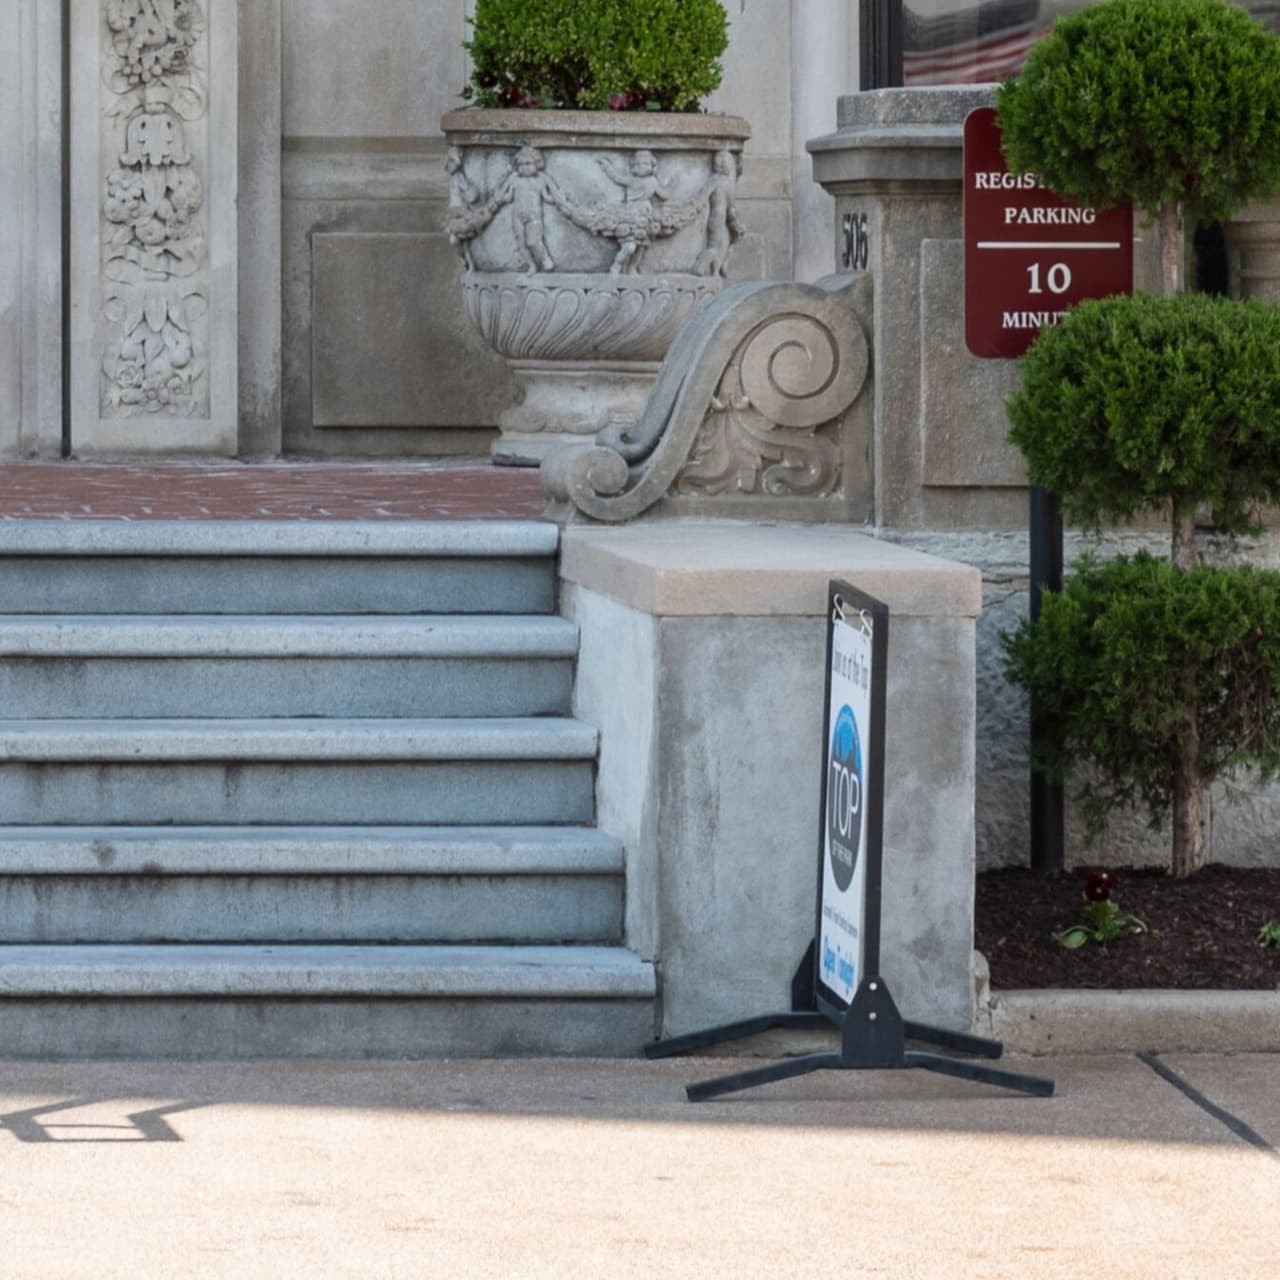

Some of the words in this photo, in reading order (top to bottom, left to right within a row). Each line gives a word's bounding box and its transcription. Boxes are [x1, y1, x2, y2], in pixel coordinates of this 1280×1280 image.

[975, 172, 1054, 189] REGIS
[1005, 207, 1095, 224] PARKING
[842, 213, 868, 270] 506
[1026, 262, 1072, 293] 10
[1002, 311, 1071, 328] MINU
[832, 760, 860, 840] TOP
